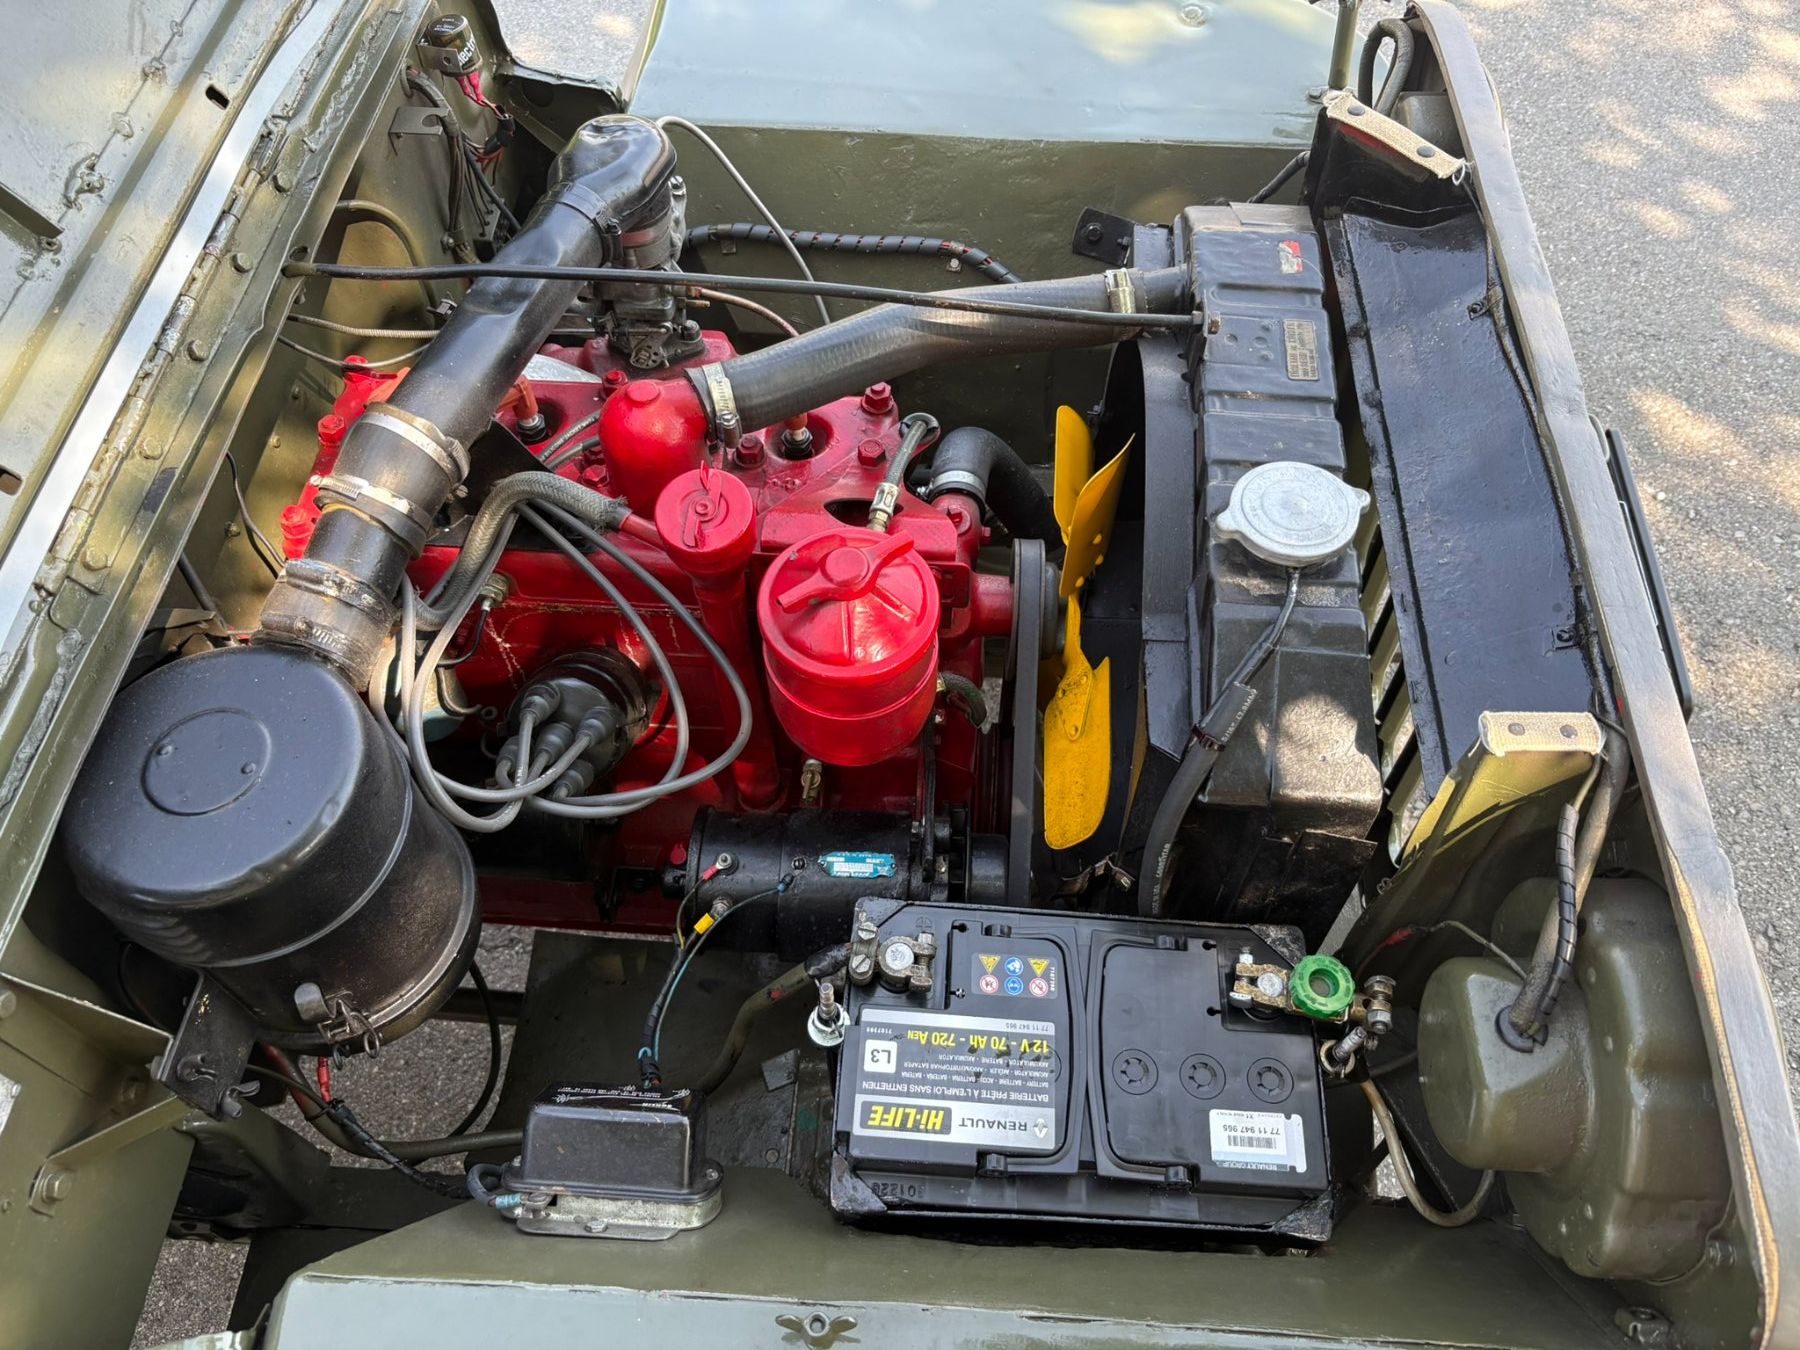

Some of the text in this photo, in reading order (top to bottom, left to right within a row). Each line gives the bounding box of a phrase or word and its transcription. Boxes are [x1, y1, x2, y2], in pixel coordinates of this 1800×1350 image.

[931, 1032, 955, 1046] 720
[969, 1034, 987, 1049] Ah
[991, 1036, 1006, 1050] 70
[1020, 1038, 1030, 1051] V
[1034, 1039, 1049, 1053] 12
[870, 1048, 891, 1065] L3
[862, 1080, 1049, 1102] BATTERIE PRÊTE À L'EMPLOI SANS ENTRETIEN
[958, 1117, 1027, 1132] RENAULT
[1222, 1124, 1238, 1132] 965
[1247, 1162, 1277, 1170] RENAULT
